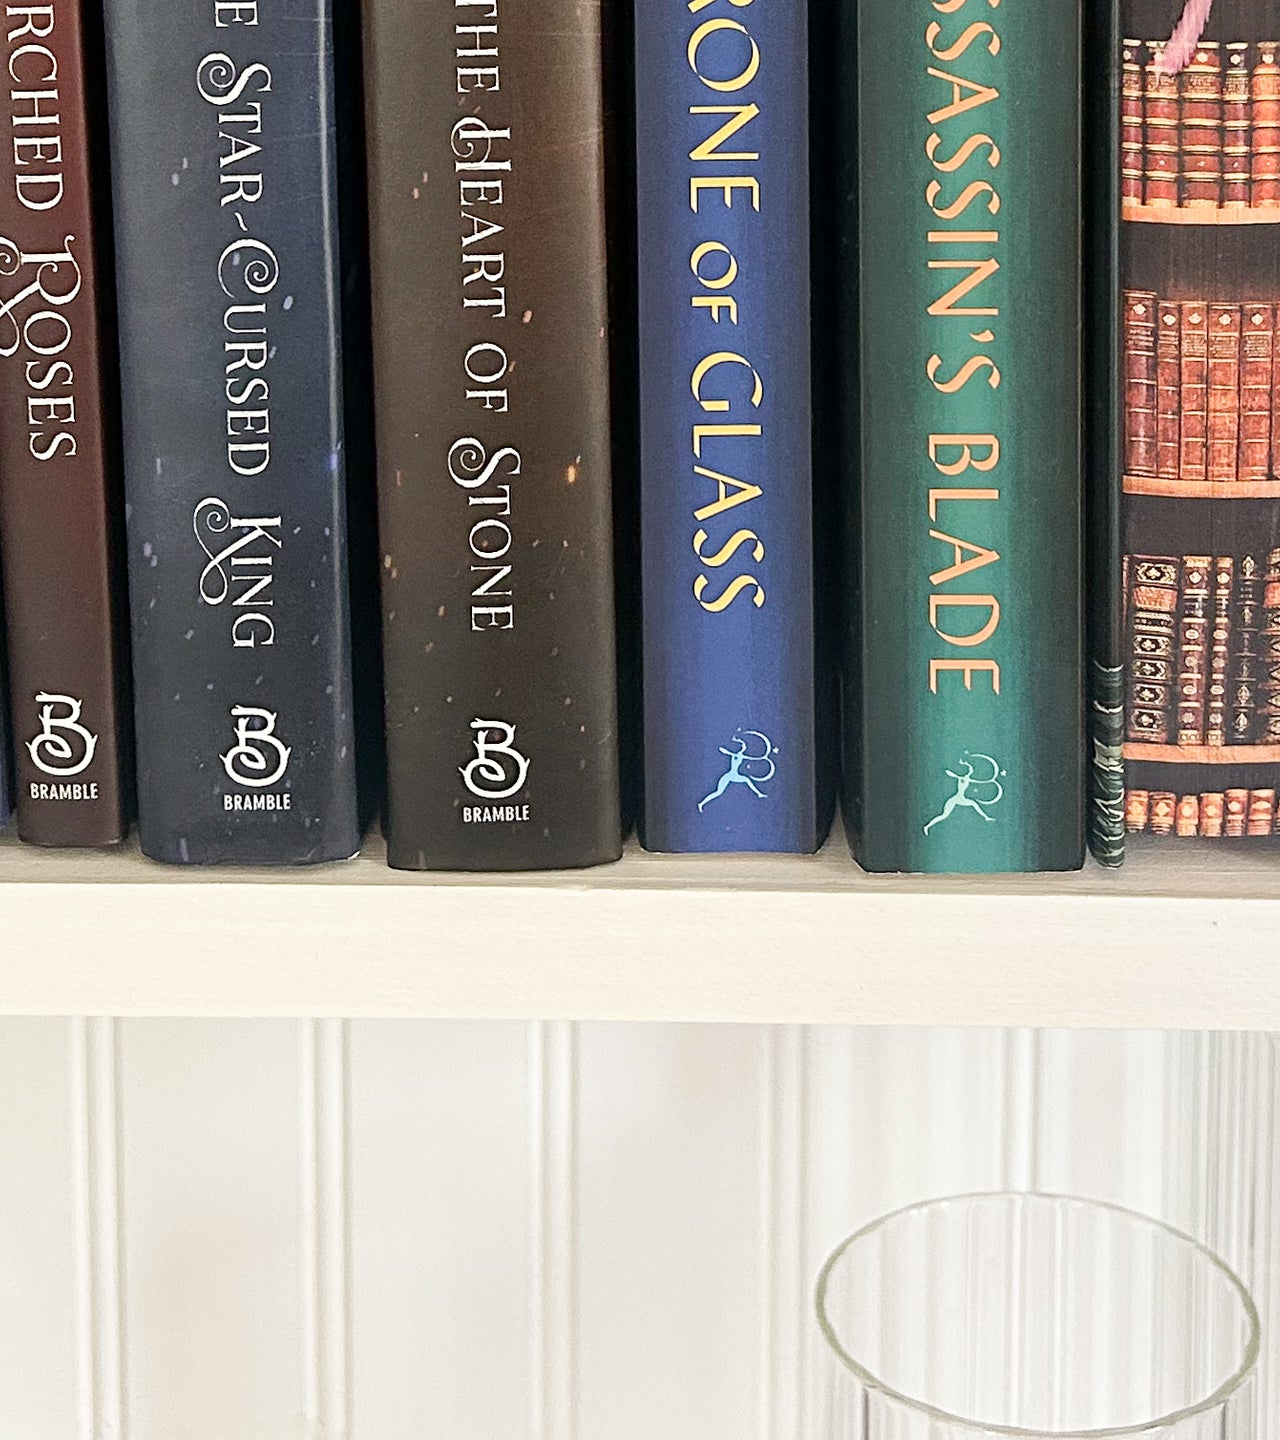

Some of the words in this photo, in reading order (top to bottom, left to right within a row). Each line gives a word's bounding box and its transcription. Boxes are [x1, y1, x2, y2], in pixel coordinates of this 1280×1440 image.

[450, 116, 512, 320] HEART
[688, 240, 740, 326] OF
[463, 340, 510, 413] OF
[447, 436, 522, 633] STONE
[690, 350, 767, 615] GLASS
[193, 496, 283, 650] KING
[927, 432, 1001, 696] BLADE
[29, 781, 99, 802] BRAMBLE
[223, 791, 292, 812] BRAMBLE
[462, 802, 531, 824] BRAMBLE
